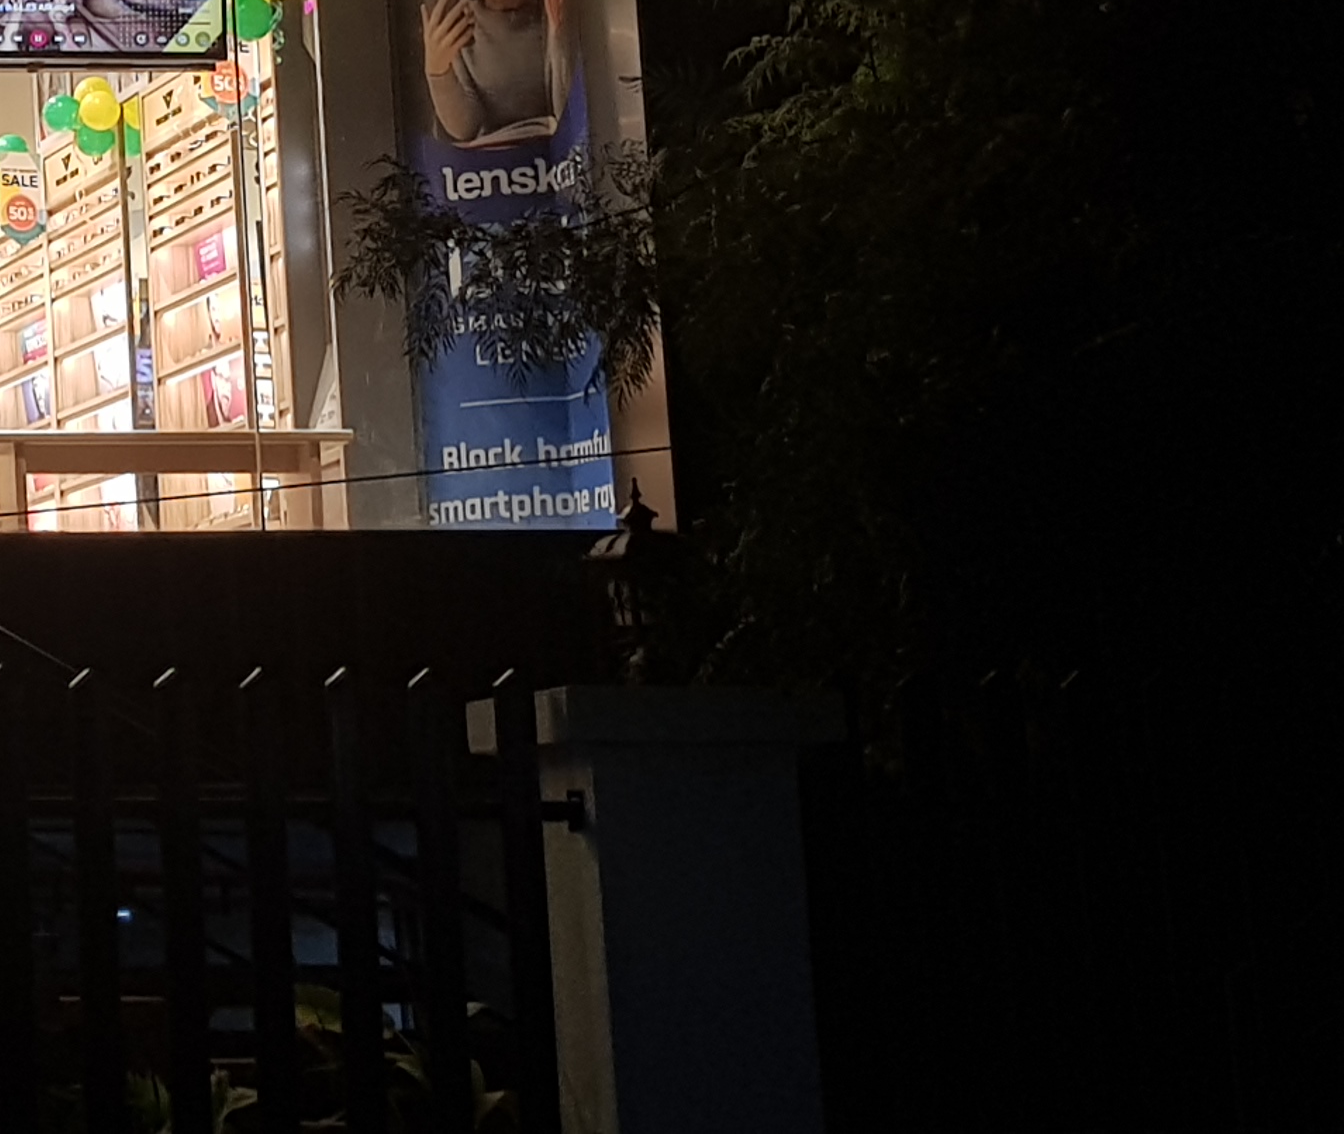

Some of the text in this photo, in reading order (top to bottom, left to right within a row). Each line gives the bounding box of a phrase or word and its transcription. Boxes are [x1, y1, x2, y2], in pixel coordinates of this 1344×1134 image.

[1, 173, 39, 189] SALE
[442, 438, 523, 474] Block
[428, 485, 589, 525] smartphone
